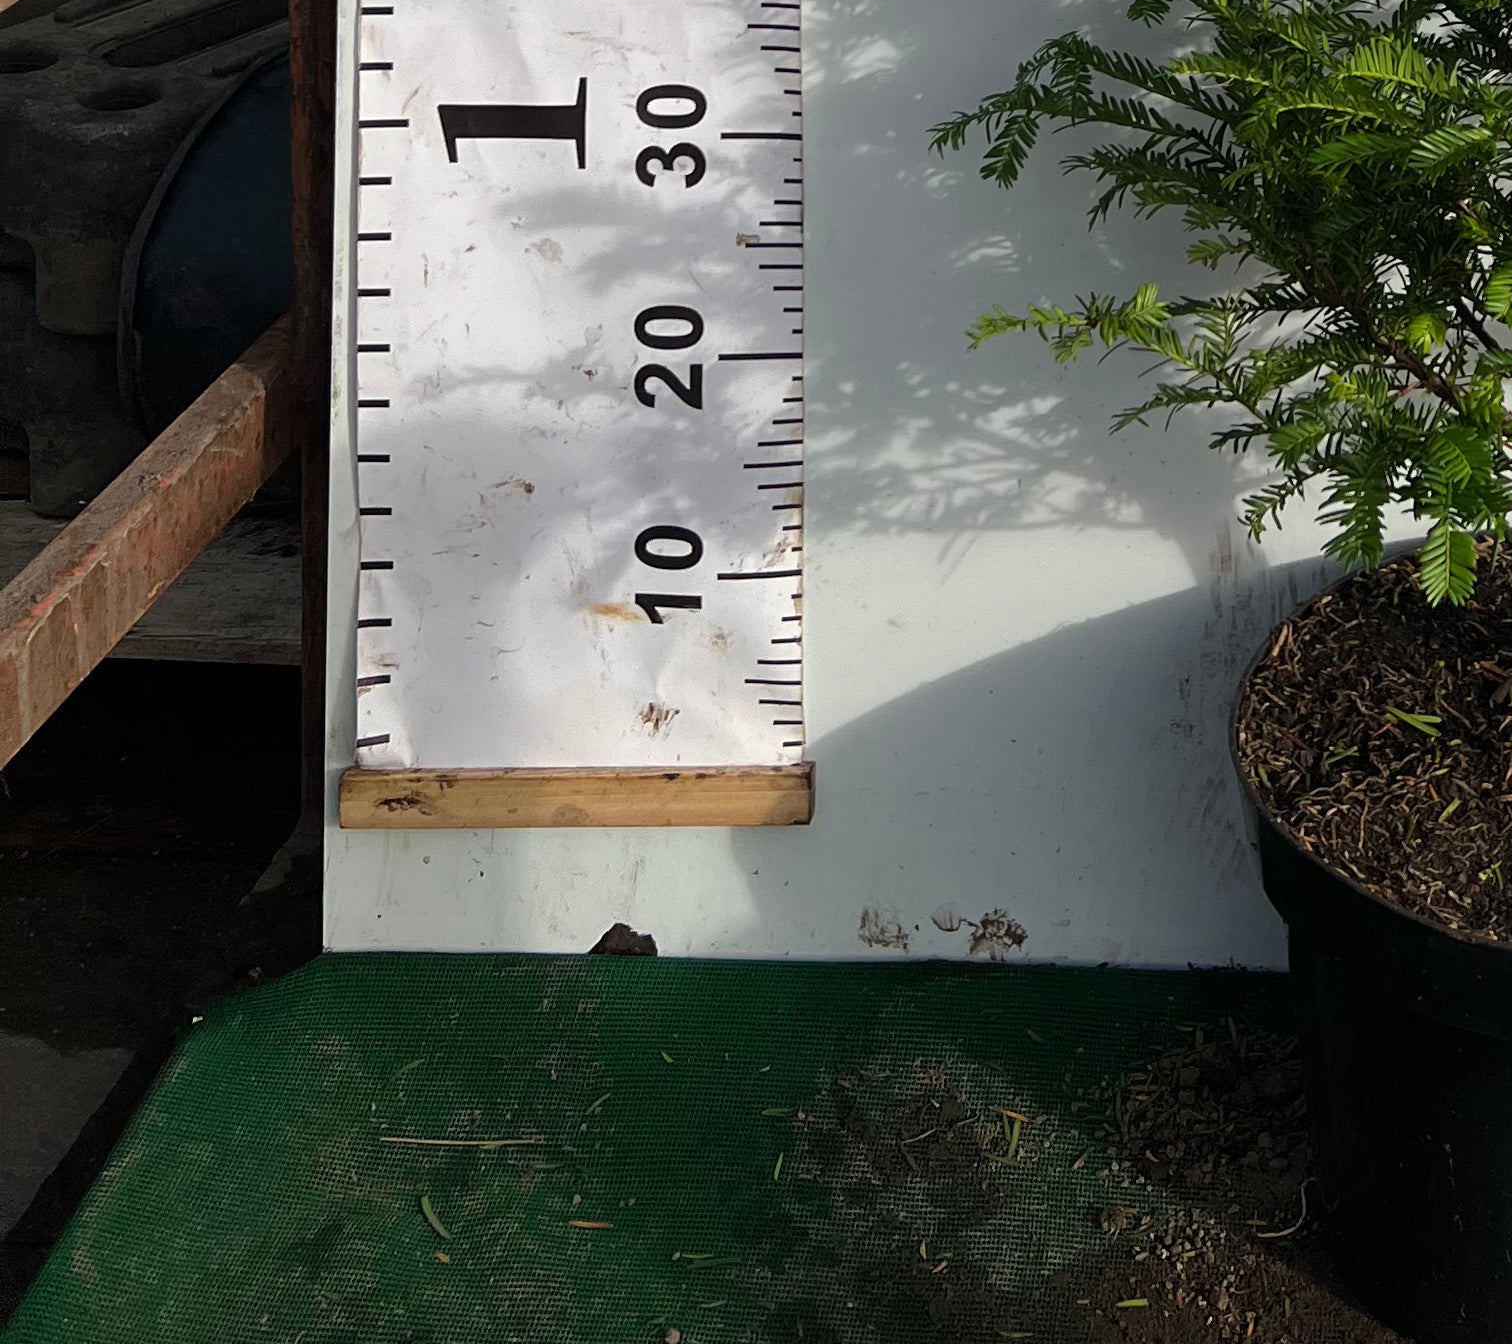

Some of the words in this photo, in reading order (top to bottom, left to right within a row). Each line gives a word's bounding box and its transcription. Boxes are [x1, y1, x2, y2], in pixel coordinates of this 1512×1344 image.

[436, 76, 588, 170] 1
[634, 84, 708, 189] 30
[633, 304, 704, 411] 20
[633, 524, 704, 625] 10
